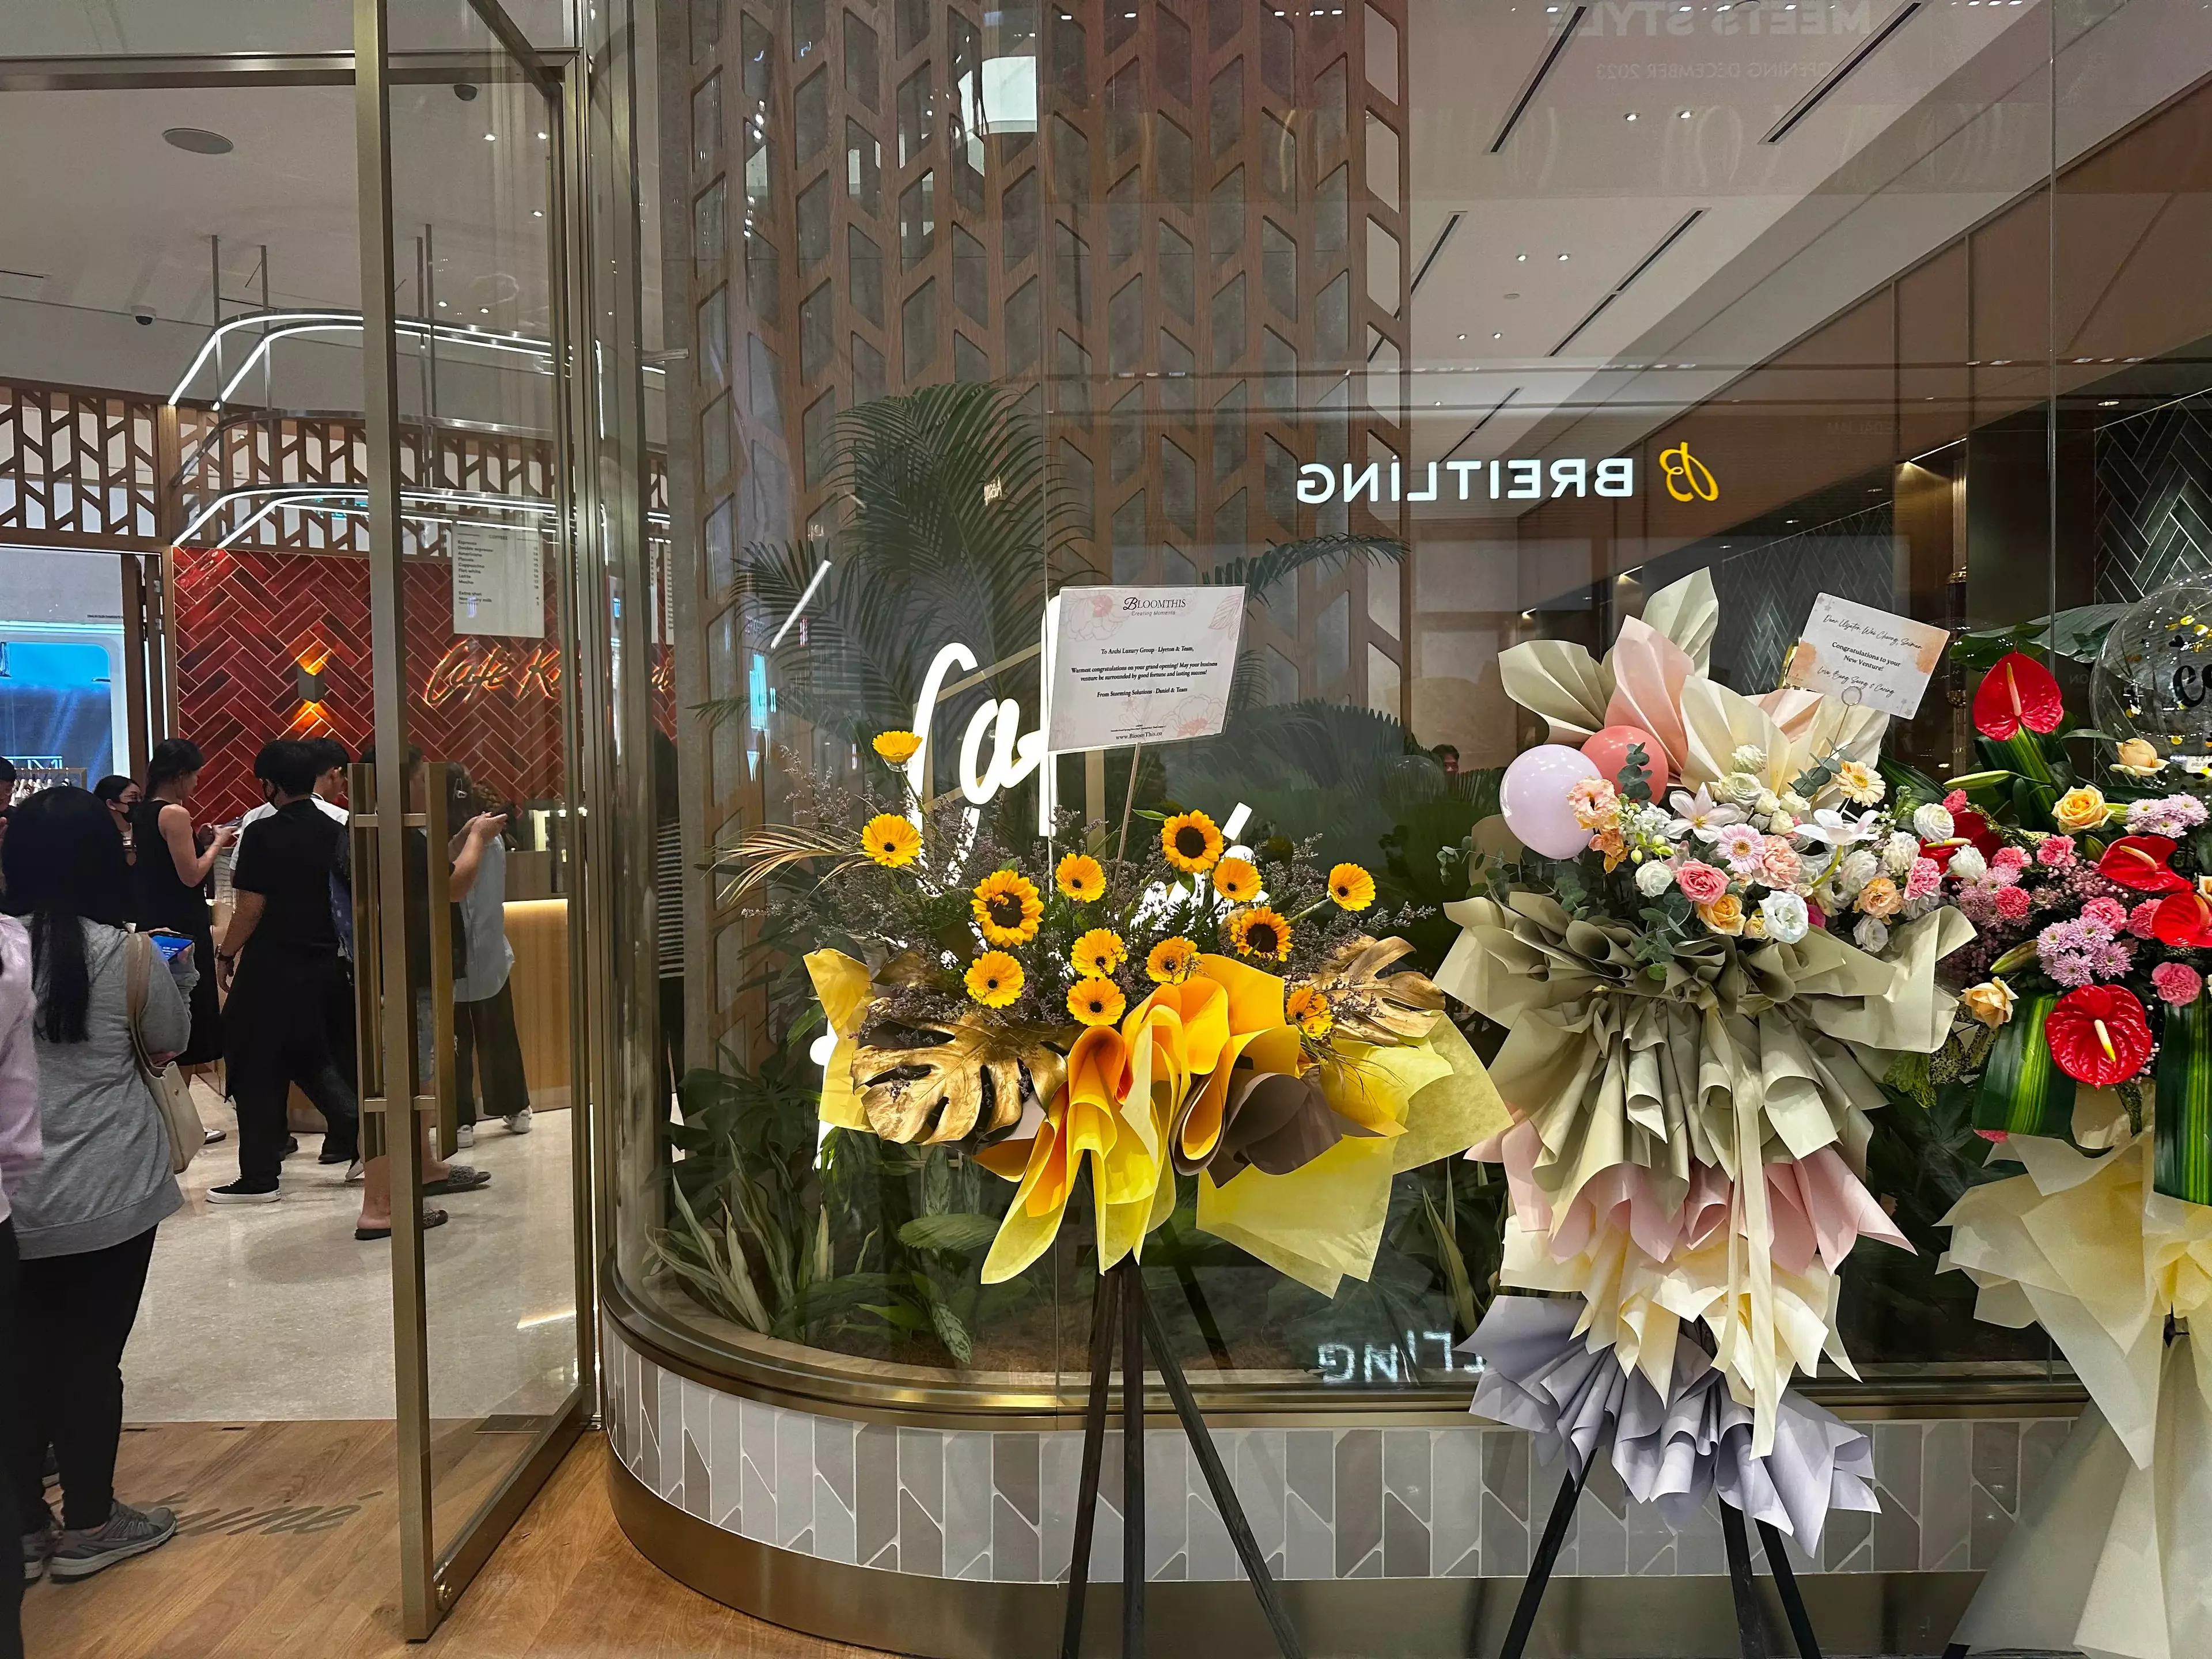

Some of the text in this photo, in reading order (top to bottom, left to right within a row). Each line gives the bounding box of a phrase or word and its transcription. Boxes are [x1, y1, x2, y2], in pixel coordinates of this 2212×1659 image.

[1832, 642, 1880, 661] Congratulations
[1887, 658, 1901, 667] your
[1844, 654, 1884, 671] New Venture!
[1092, 665, 1127, 673] congratulations
[1115, 732, 1162, 740] www.BloomThis.co
